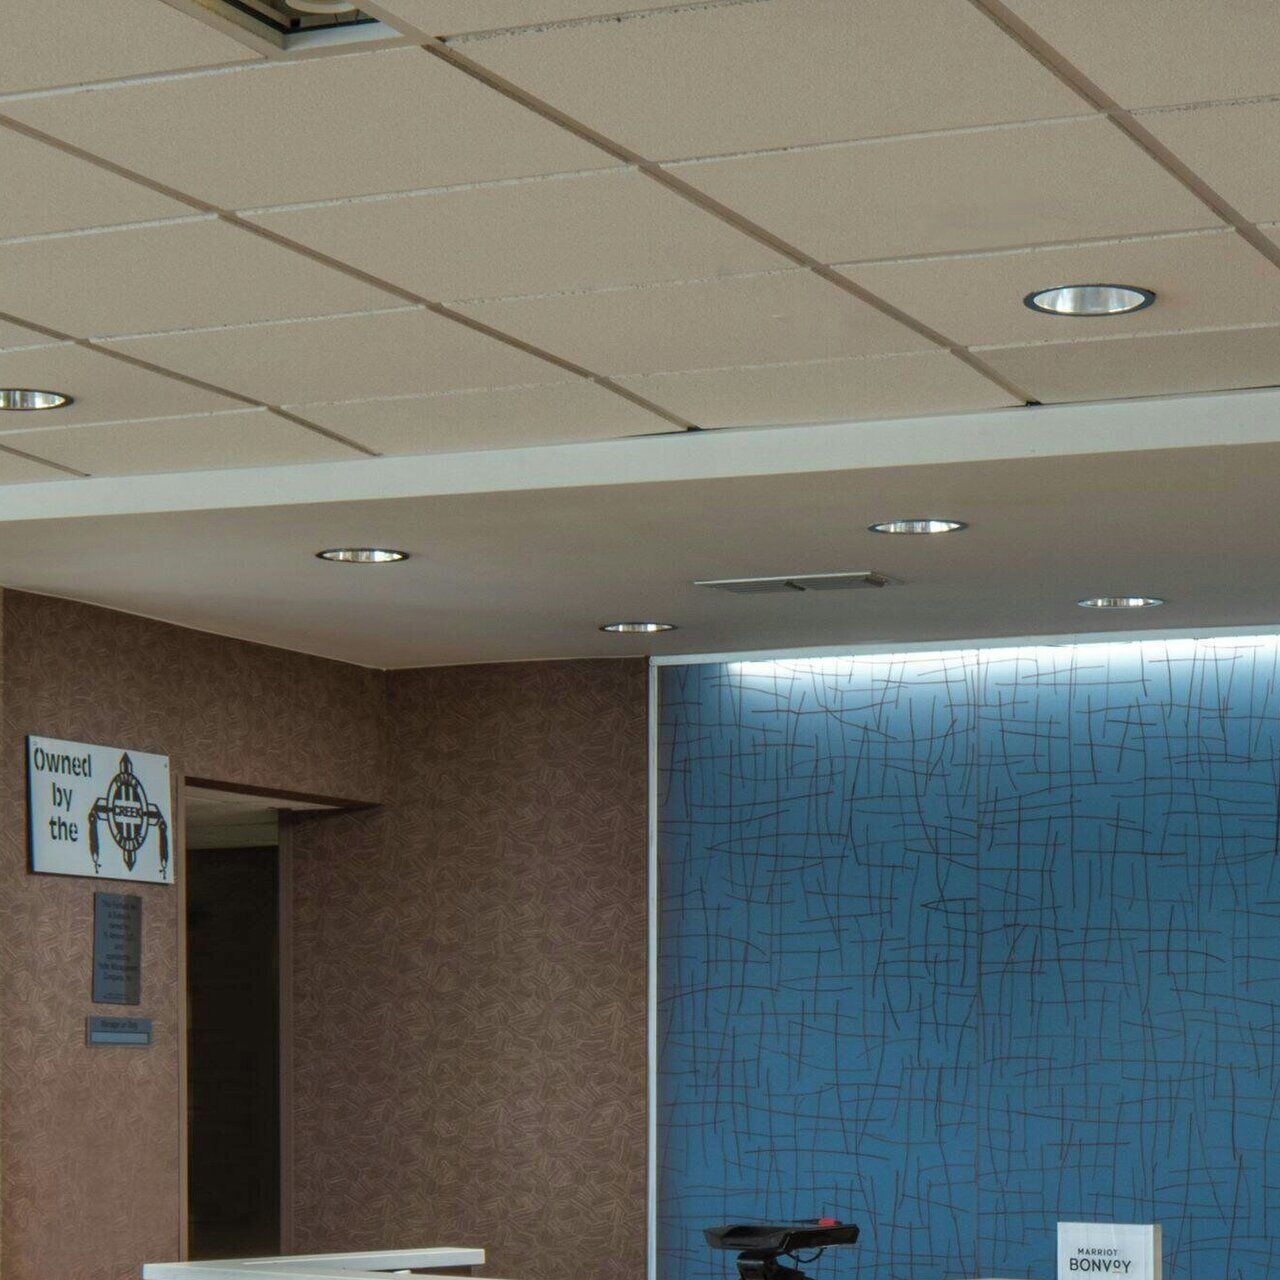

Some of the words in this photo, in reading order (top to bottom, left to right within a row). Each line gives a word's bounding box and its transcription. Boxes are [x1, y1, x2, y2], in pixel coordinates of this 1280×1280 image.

[33, 745, 93, 779] Owned
[52, 782, 74, 814] by
[112, 804, 142, 818] CREEK
[49, 816, 79, 843] the
[1077, 1247, 1123, 1257] MARRIOT
[1069, 1257, 1132, 1275] BONVOY
